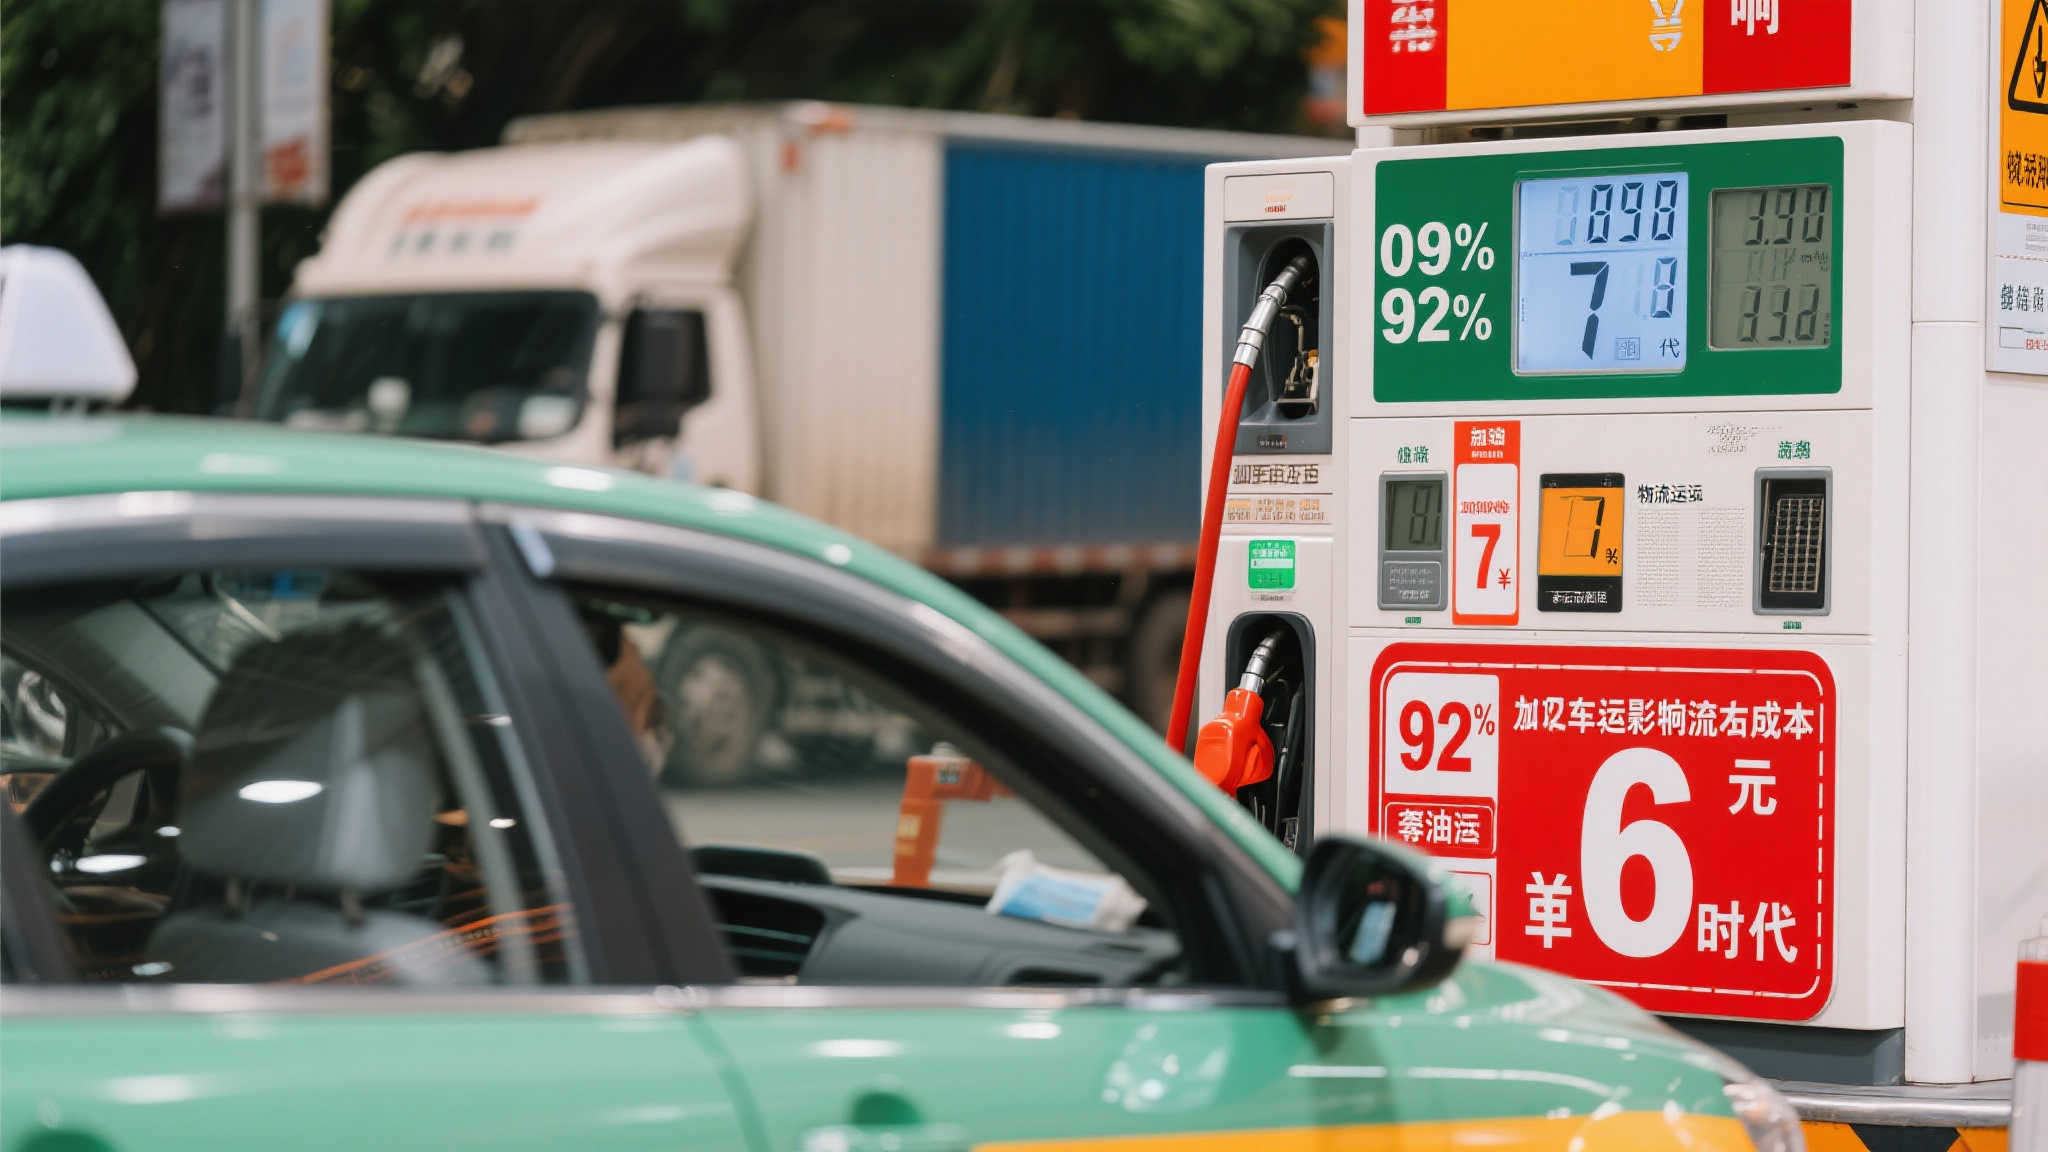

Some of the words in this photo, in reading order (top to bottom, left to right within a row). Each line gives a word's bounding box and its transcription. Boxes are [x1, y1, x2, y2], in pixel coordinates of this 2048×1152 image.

[1380, 221, 1495, 277] 09%
[1381, 286, 1493, 344] 92%
[1472, 524, 1501, 589] 7
[1400, 700, 1495, 772] 92%
[1728, 759, 1778, 816] 元
[1580, 747, 1694, 958] 6
[1698, 901, 1799, 964] 时代
